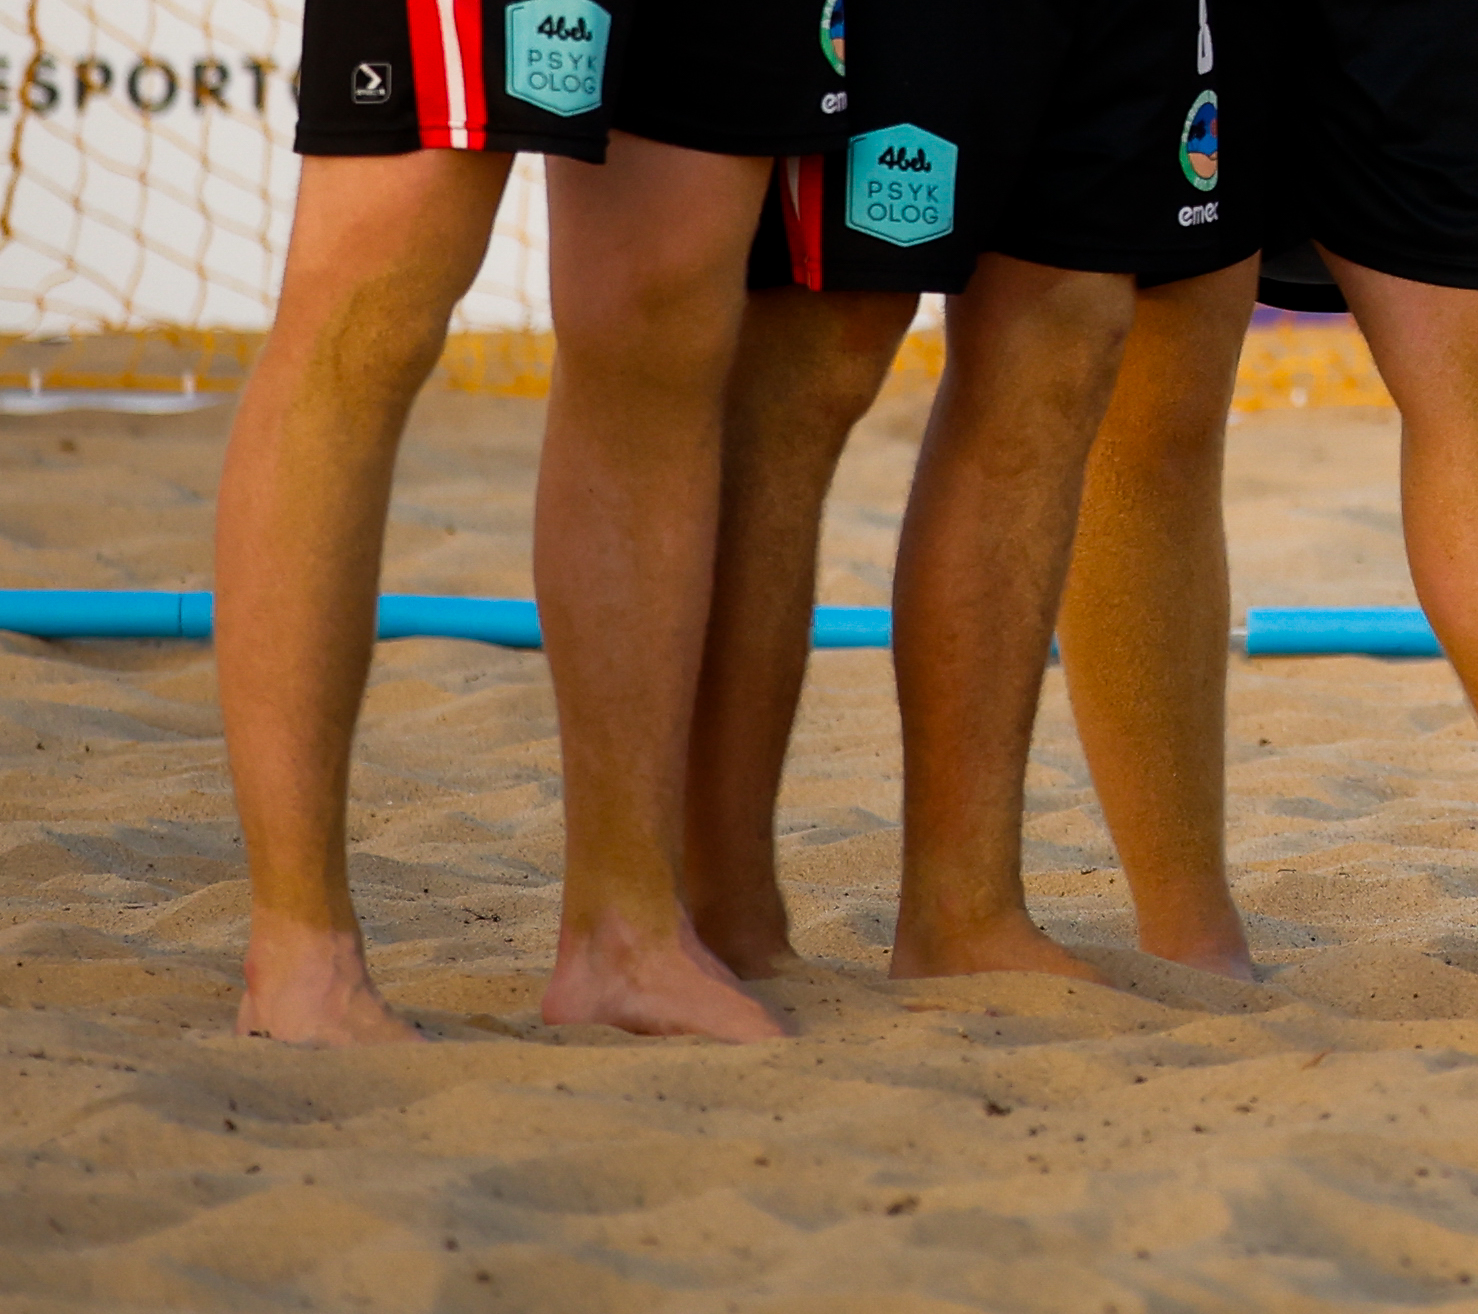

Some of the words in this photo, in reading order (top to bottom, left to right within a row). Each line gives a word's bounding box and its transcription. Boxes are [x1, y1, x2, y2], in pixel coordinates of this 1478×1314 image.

[527, 49, 598, 72] PSYK
[0, 56, 300, 115] SPORT
[529, 71, 597, 94] OLOG
[867, 181, 939, 203] PSYK
[867, 203, 939, 225] OLOG
